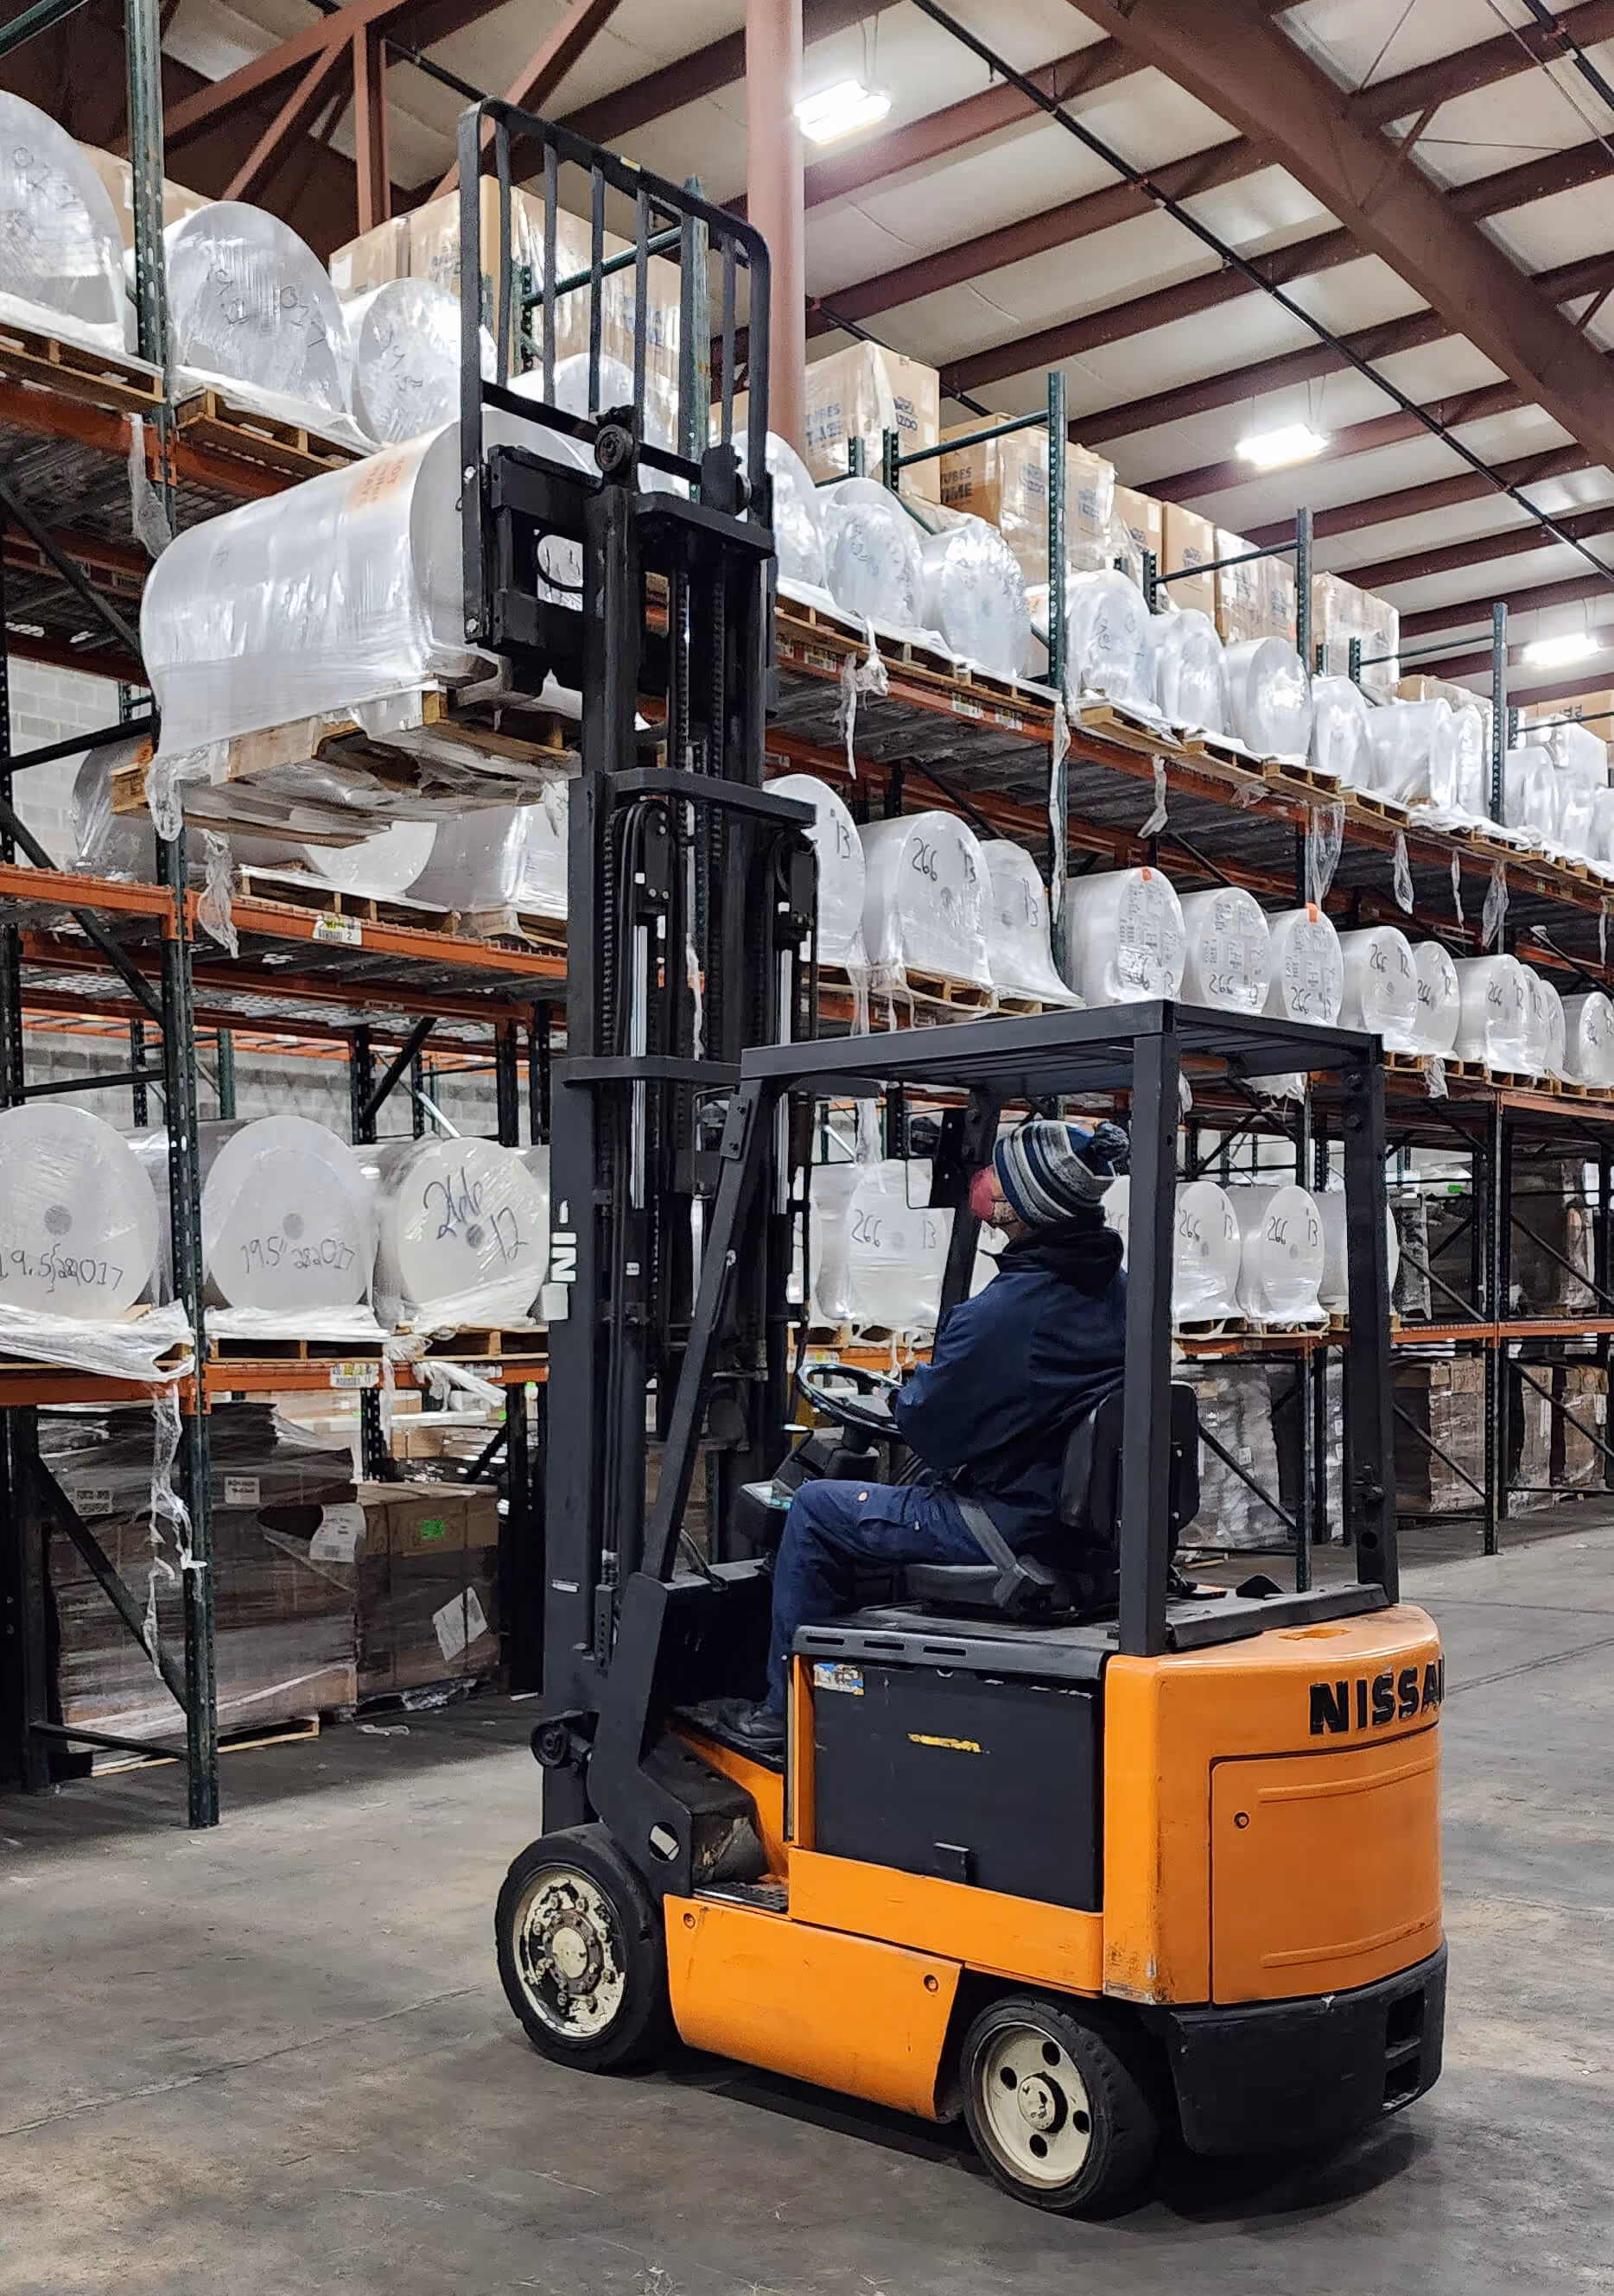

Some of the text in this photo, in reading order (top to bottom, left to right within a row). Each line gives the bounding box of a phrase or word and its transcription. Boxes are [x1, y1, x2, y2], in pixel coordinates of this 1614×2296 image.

[912, 837, 937, 882] 266
[851, 1209, 882, 1248] 266
[1268, 1215, 1288, 1245] 266
